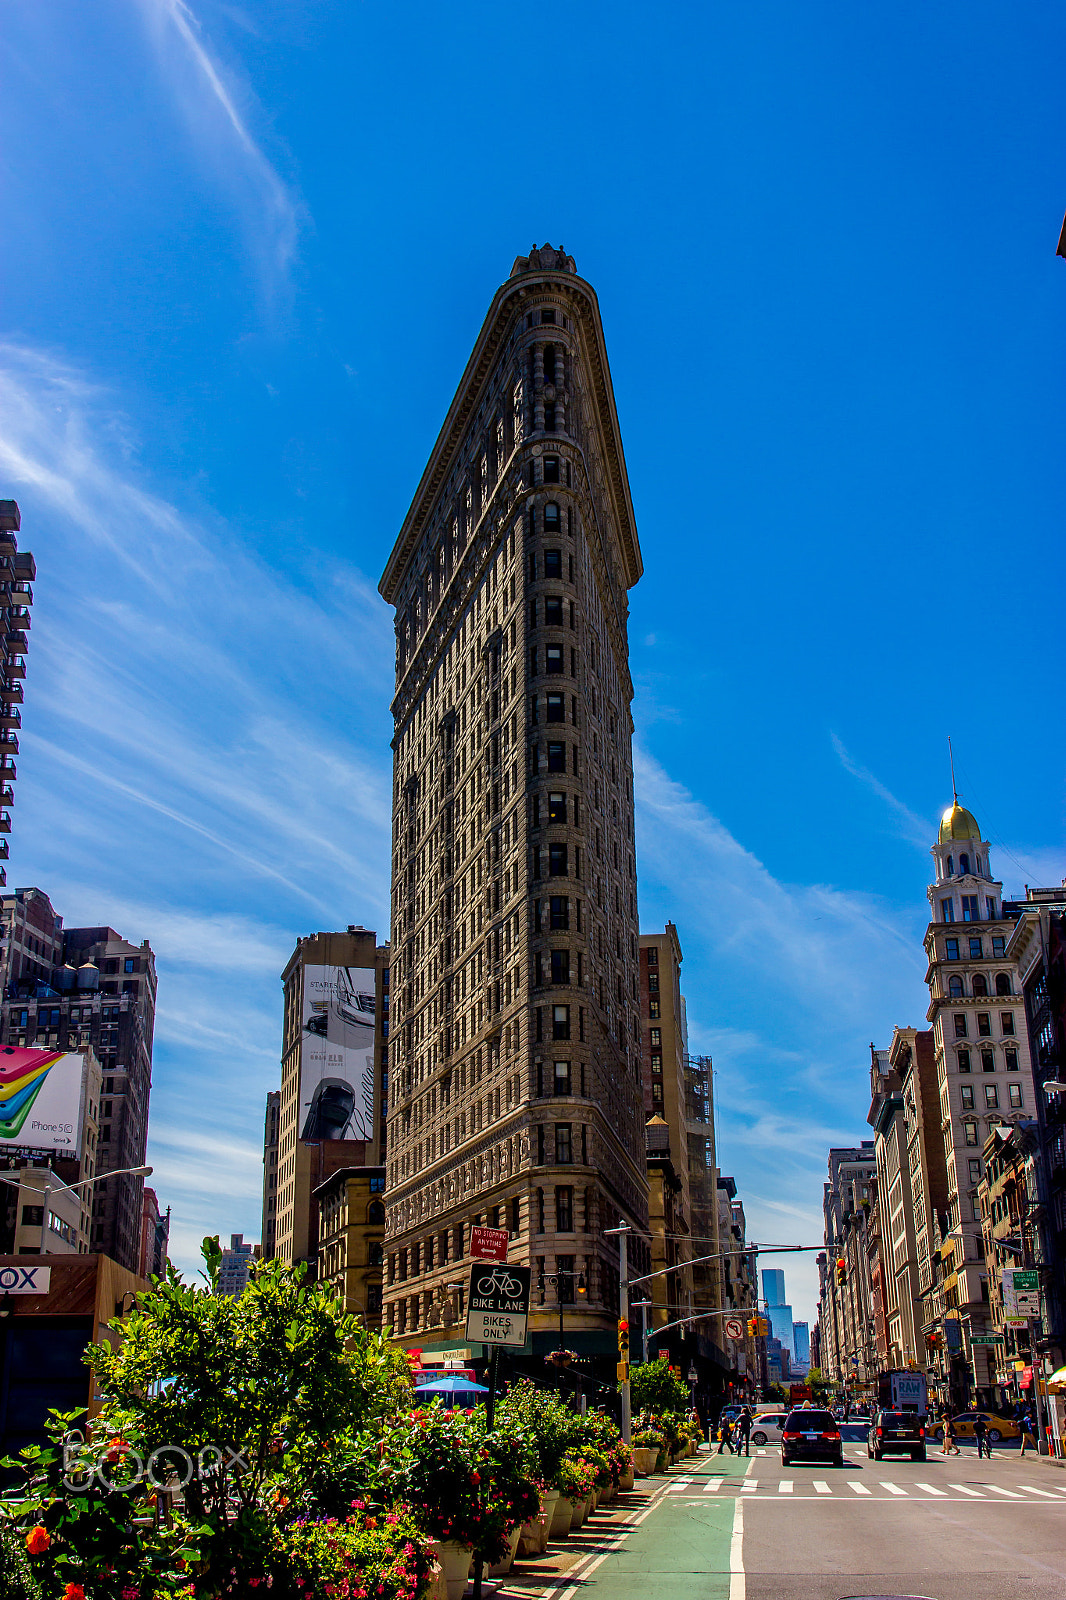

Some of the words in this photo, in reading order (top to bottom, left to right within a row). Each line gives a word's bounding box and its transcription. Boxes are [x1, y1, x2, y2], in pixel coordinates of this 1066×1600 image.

[31, 1120, 57, 1132] iPhone
[474, 1228, 482, 1236] NO
[483, 1230, 507, 1240] STOPPING
[477, 1238, 502, 1248] ANYTIME
[472, 1298, 494, 1309] BIKE
[498, 1300, 525, 1311] LANE
[482, 1316, 511, 1327] BIKES
[483, 1329, 509, 1339] ONLY
[898, 1381, 921, 1394] RAW
